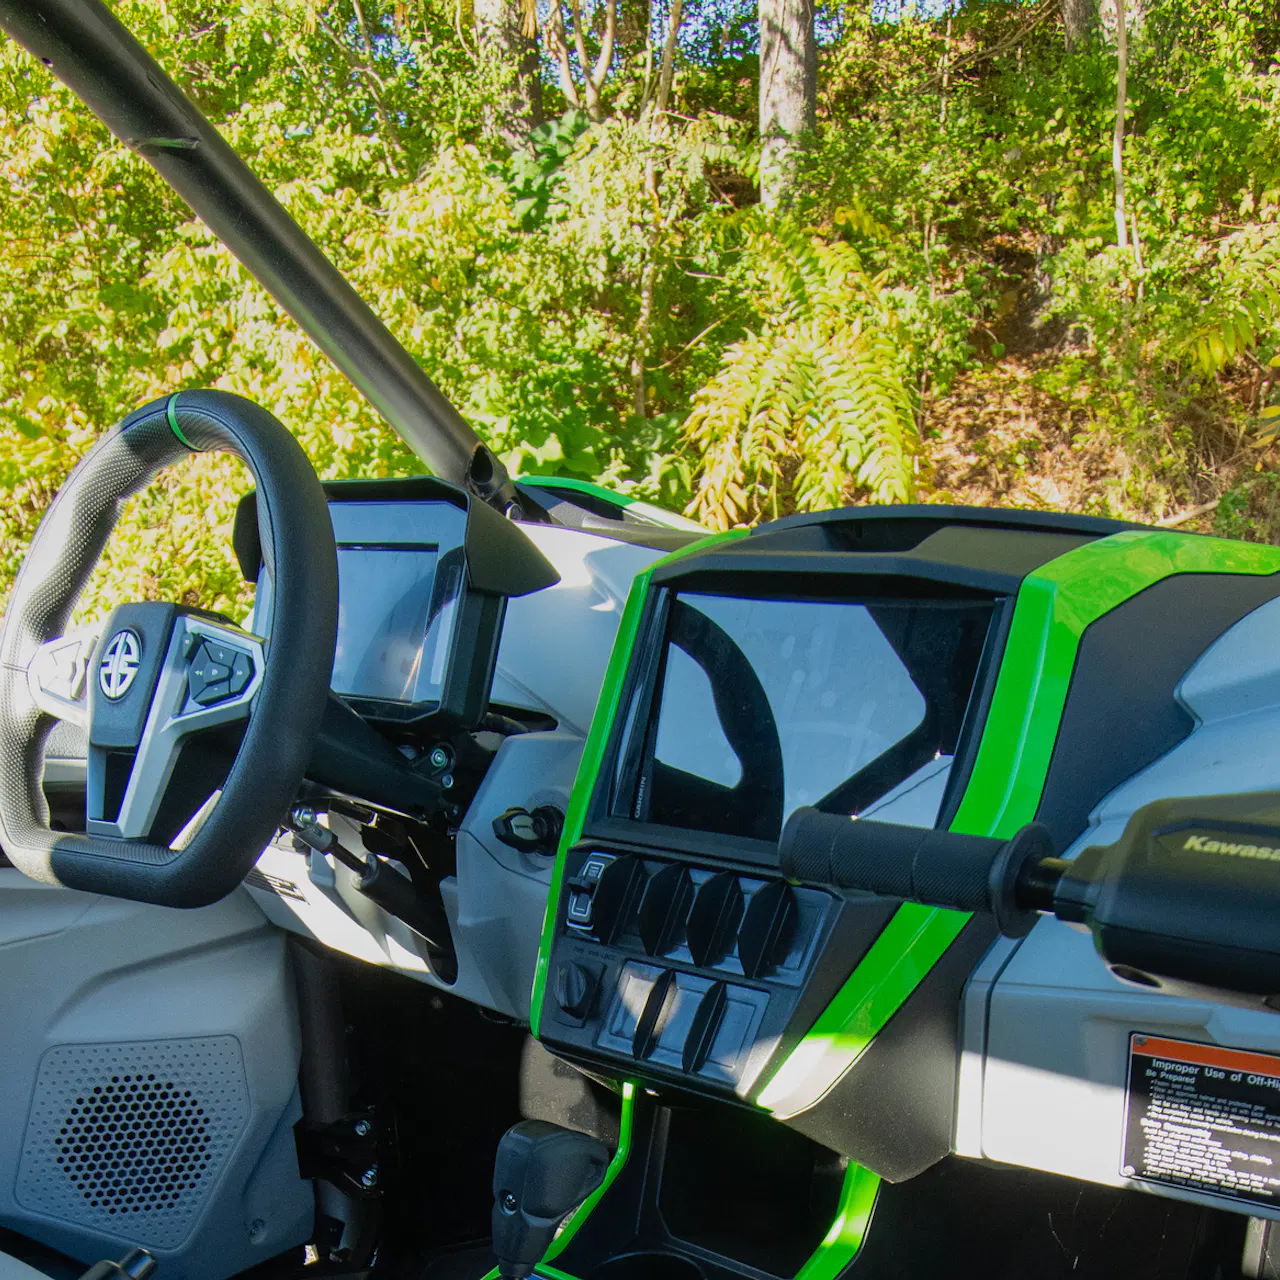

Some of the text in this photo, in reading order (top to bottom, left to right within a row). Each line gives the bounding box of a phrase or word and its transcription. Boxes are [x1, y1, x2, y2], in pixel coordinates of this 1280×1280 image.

[634, 776, 647, 818] GARMIN
[1145, 1068, 1196, 1084] Be Prepared
[1151, 1059, 1198, 1076] Improper
[1204, 1068, 1225, 1080] Use
[1230, 1072, 1241, 1083] of
